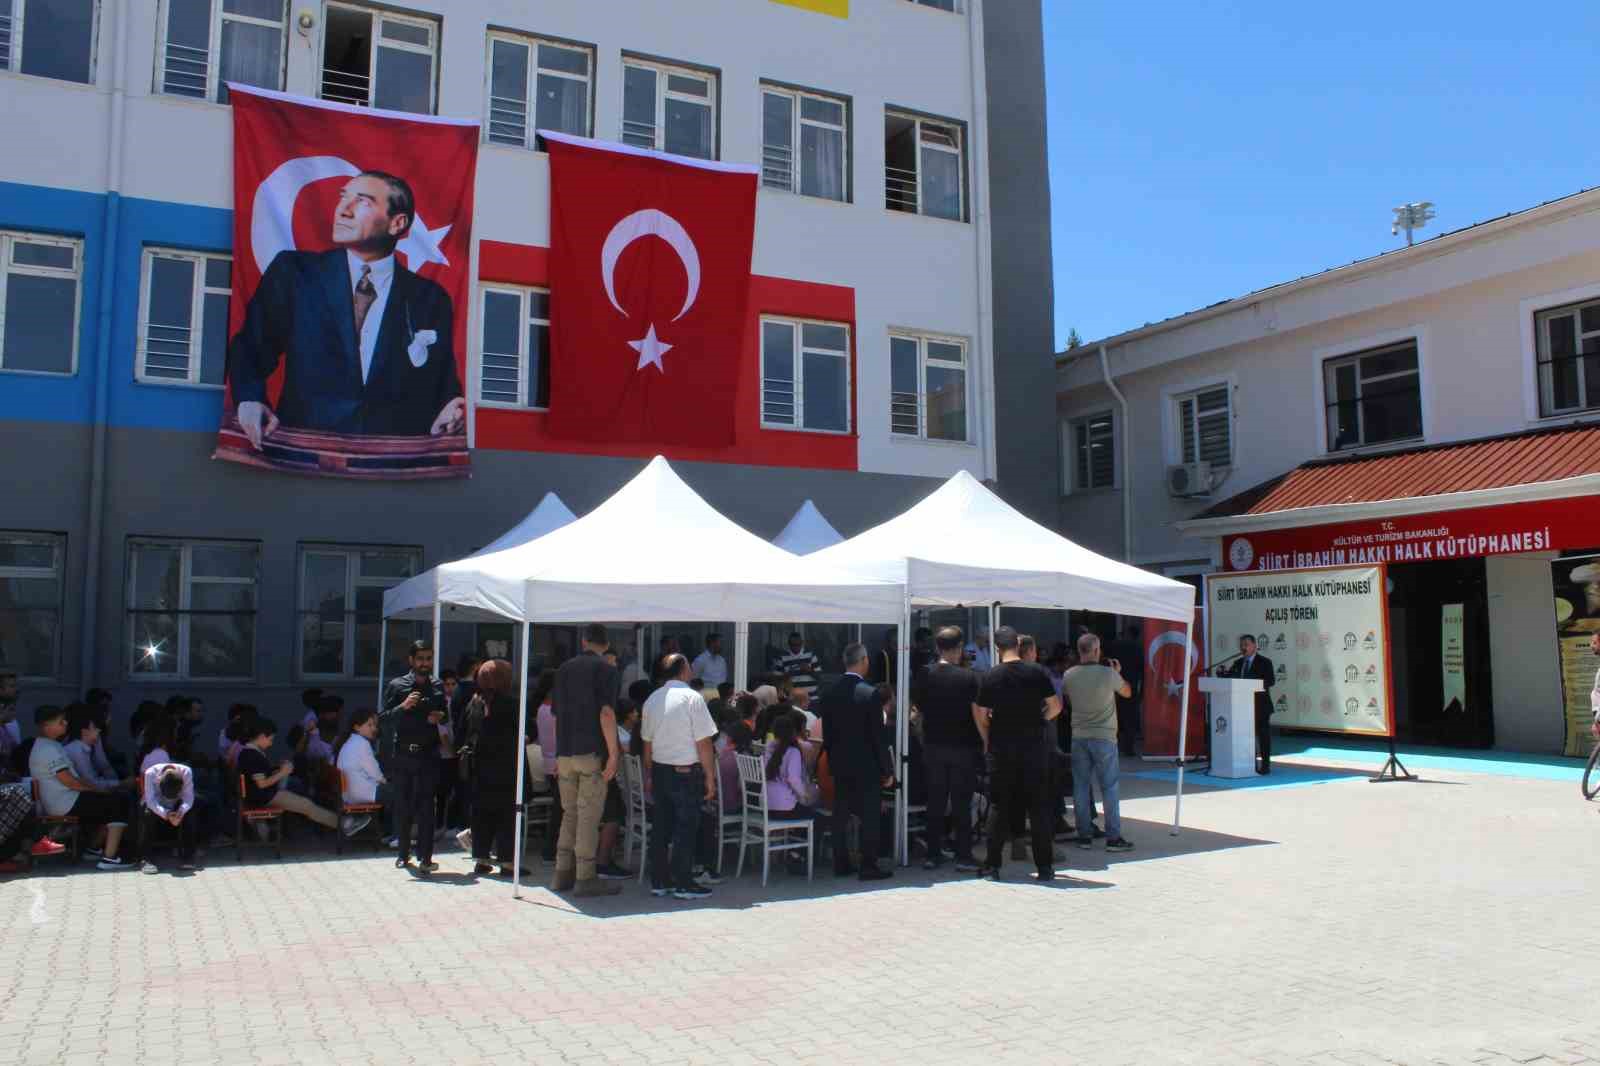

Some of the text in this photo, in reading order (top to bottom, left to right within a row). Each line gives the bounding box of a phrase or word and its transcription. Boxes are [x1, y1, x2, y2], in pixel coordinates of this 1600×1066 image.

[1333, 526, 1449, 546] KÜLTÜR VE TURİZM BAKANLIĞI
[1259, 526, 1551, 570] SİİRT İBRAHİM HAKKI HALK KÜTÜPHANESİ
[1236, 584, 1267, 600] İBRAHİM
[1268, 584, 1291, 599] HAKKI
[1292, 582, 1313, 598] HALK
[1314, 576, 1371, 597] KÜTÜPHANESİ
[1265, 605, 1318, 624] AÇILIŞ TÖRENİ
